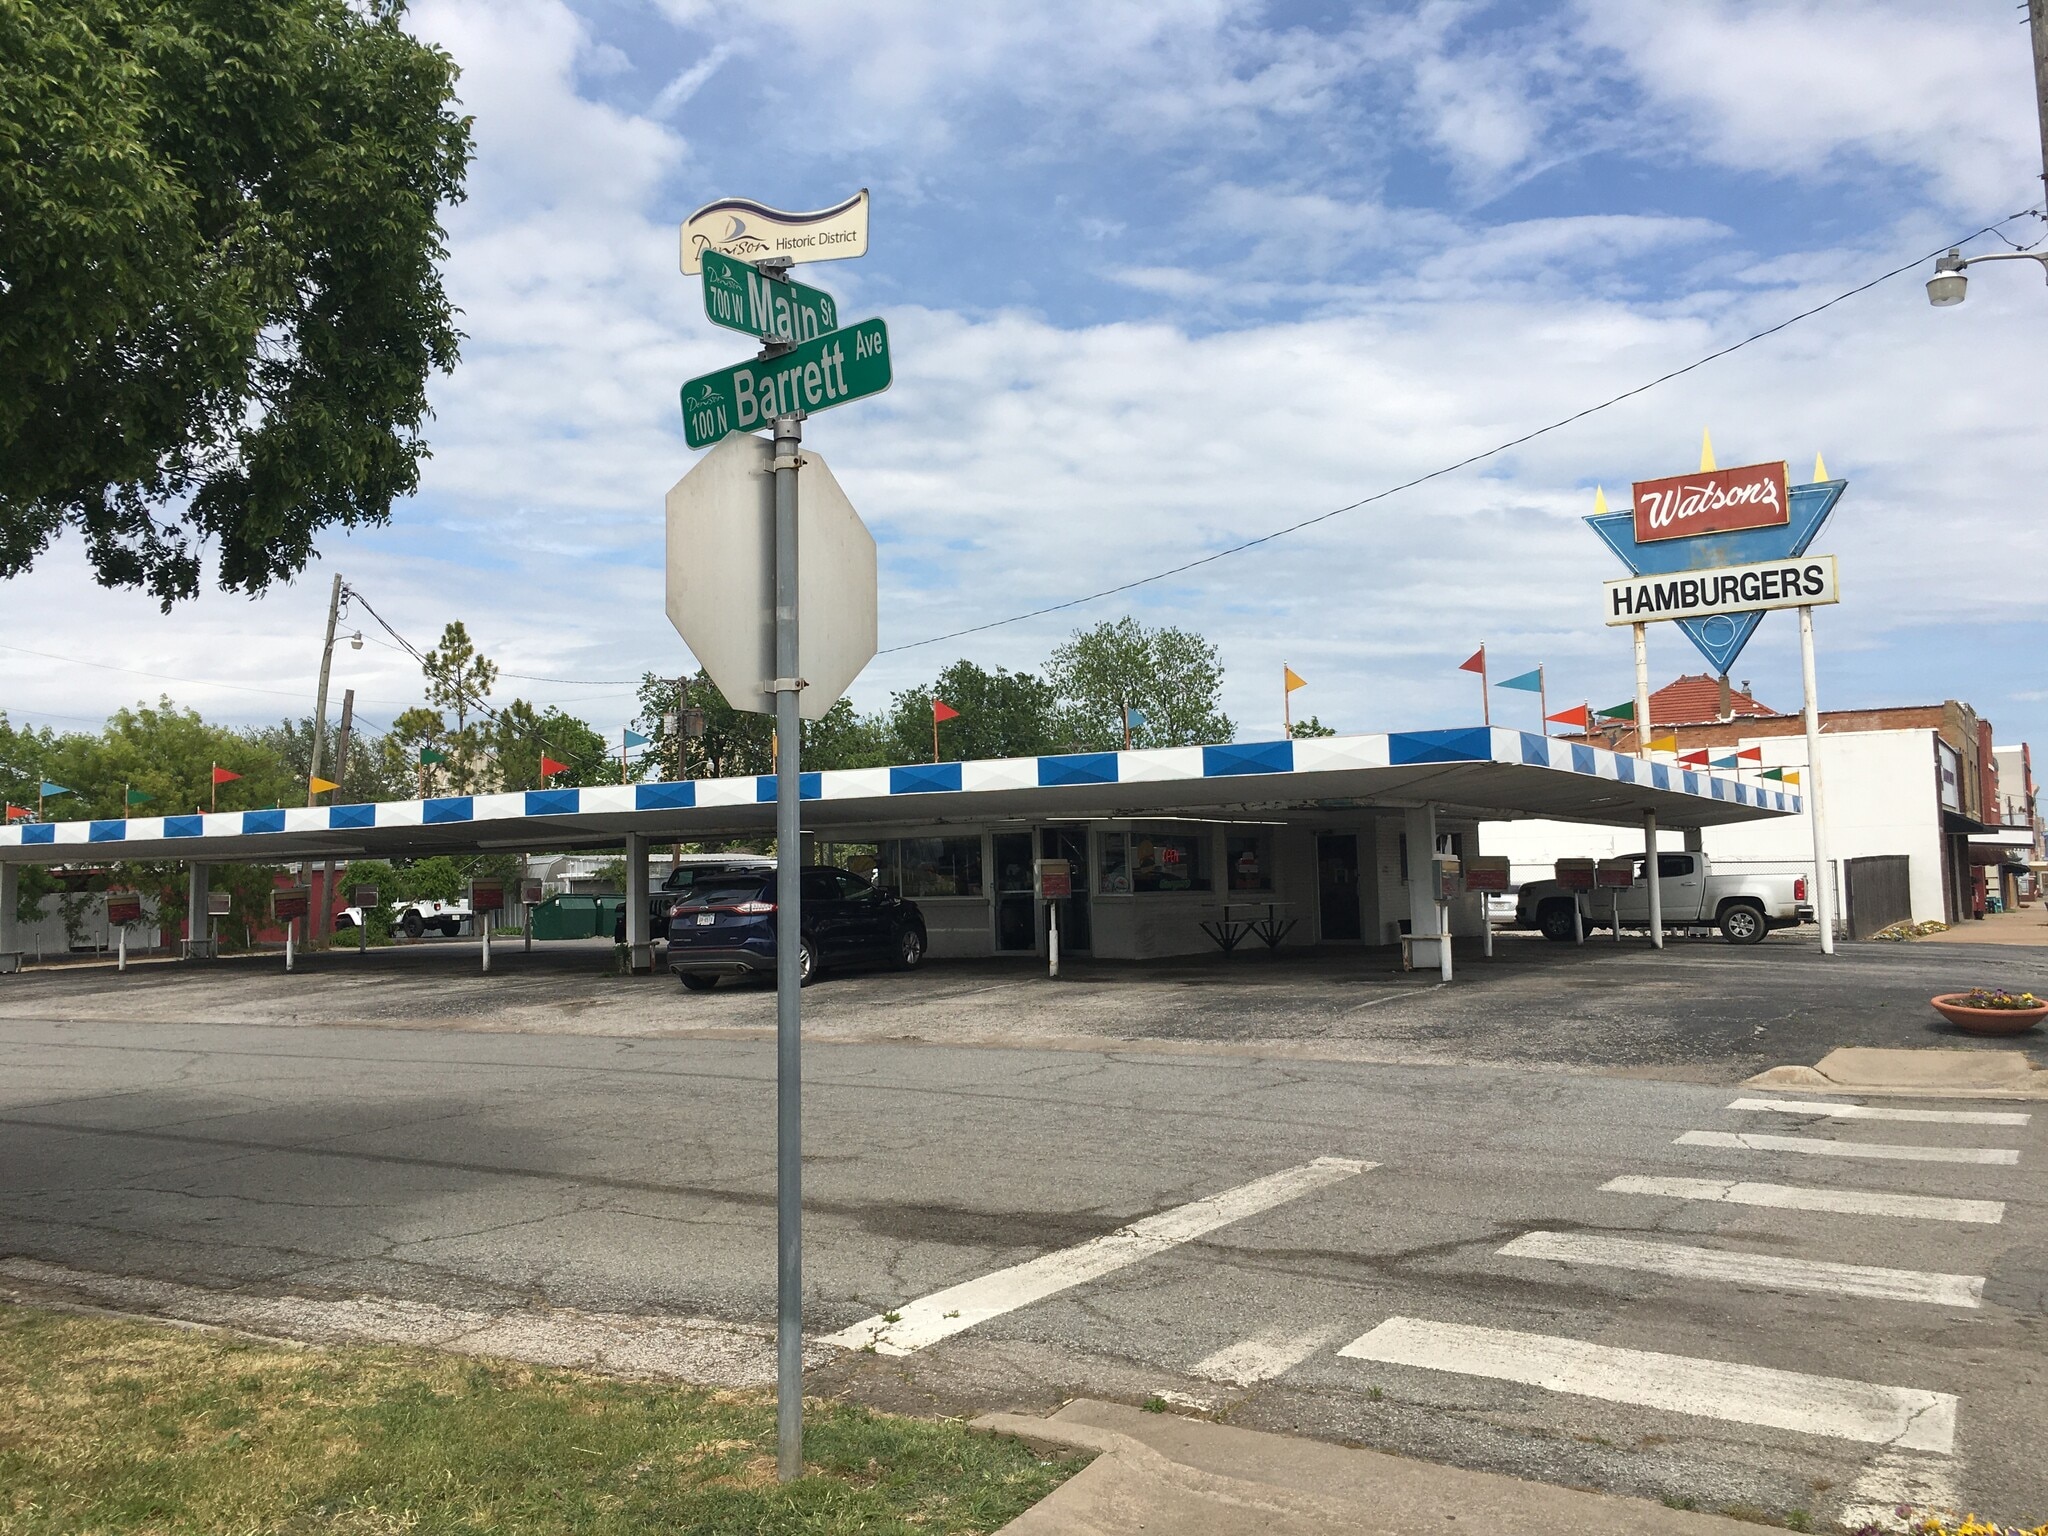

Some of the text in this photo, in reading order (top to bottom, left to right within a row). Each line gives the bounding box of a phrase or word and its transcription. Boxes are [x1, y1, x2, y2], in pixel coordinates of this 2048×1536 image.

[776, 234, 816, 251] Historic
[818, 230, 857, 246] District
[710, 271, 834, 340] 700 W Main St
[692, 330, 882, 441] 100 N Barrett Ave
[1641, 477, 1779, 528] Watson's
[1612, 565, 1824, 615] HAMBURGERS
